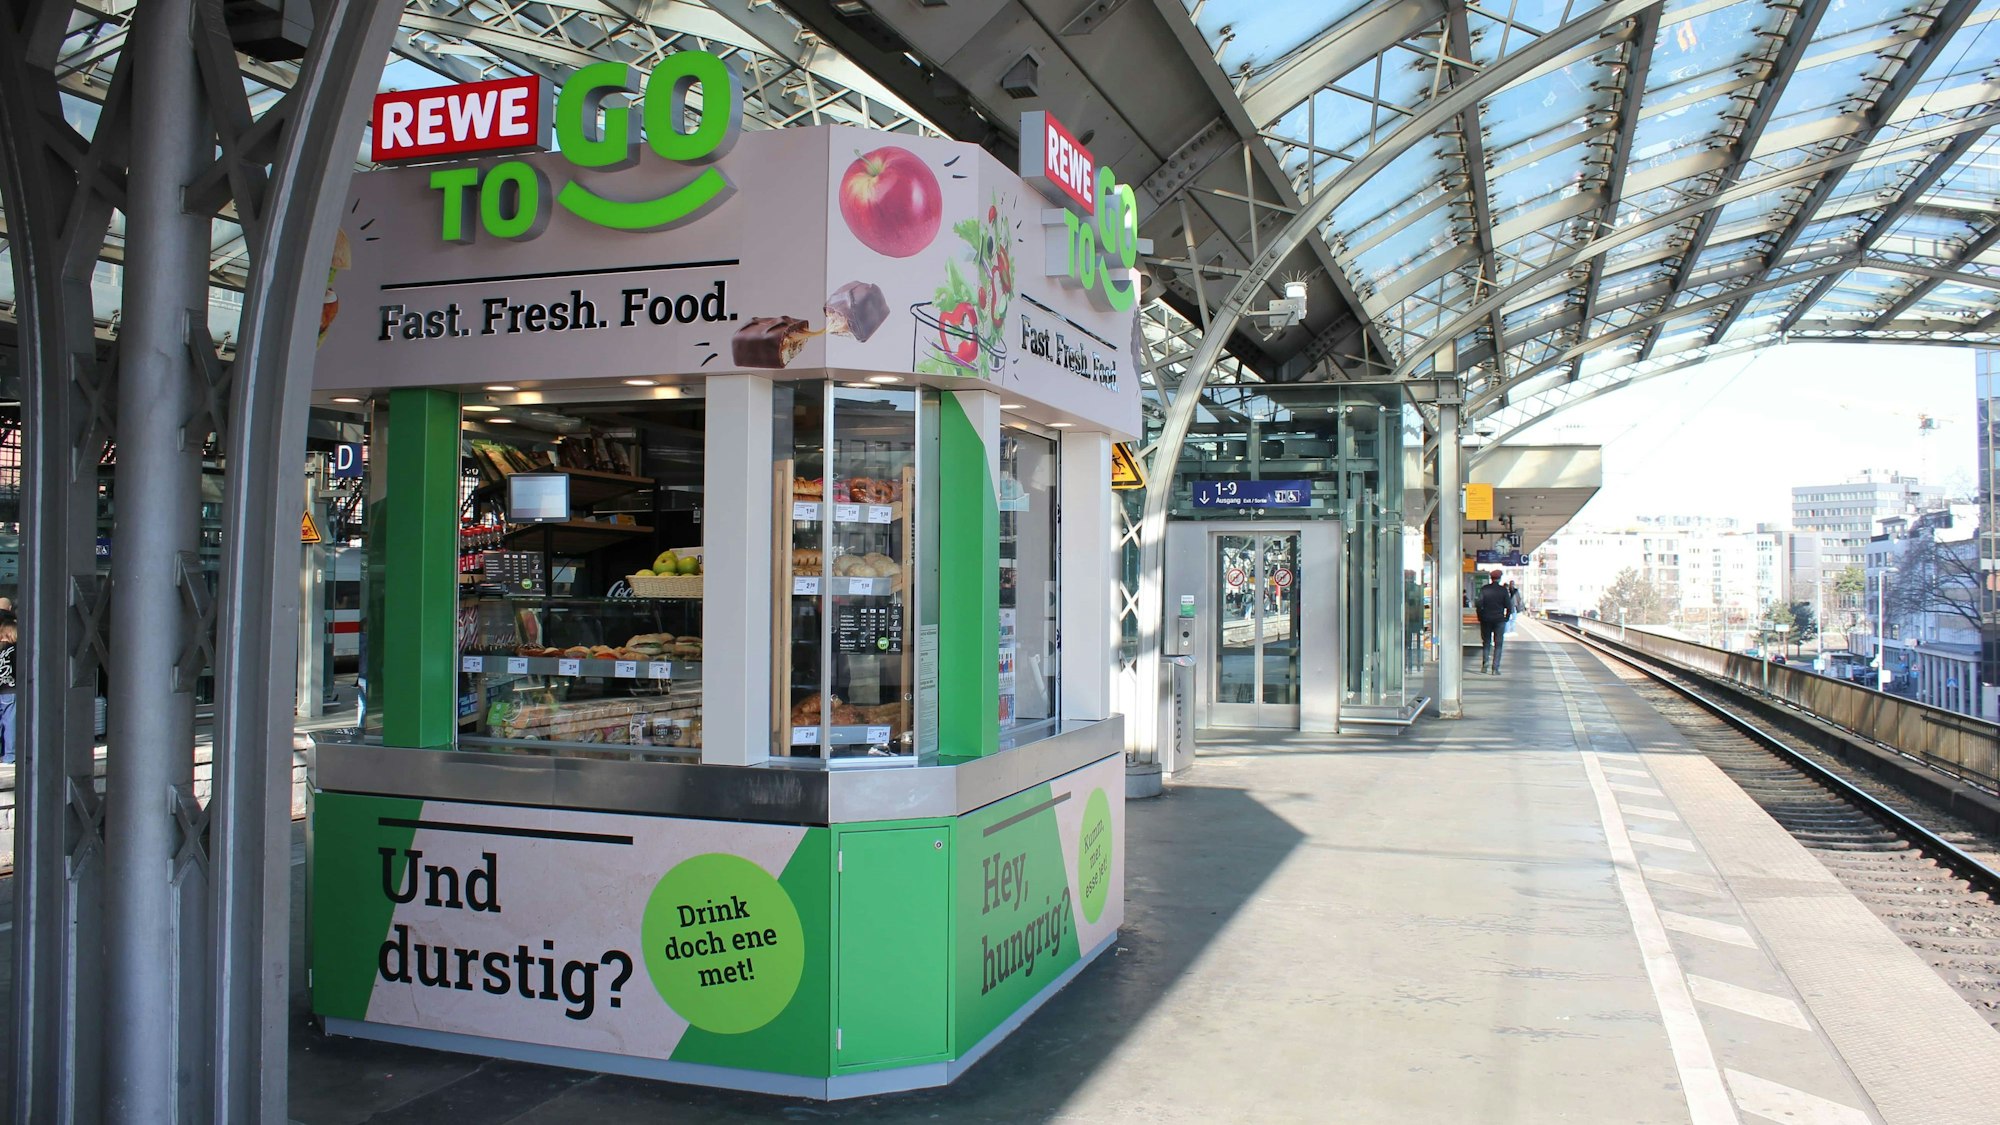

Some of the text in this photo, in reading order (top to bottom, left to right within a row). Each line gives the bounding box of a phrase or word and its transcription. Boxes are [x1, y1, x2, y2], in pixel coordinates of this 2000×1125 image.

[380, 86, 529, 150] REWE
[429, 50, 736, 242] TO GO
[1048, 124, 1092, 204] REWE
[1063, 165, 1138, 290] TO GO
[378, 280, 738, 342] Fast. Fresh. Food.
[1021, 314, 1120, 393] Fast. Fresh. Food.
[337, 444, 354, 470] D
[1215, 481, 1238, 496] 1-9
[1215, 497, 1241, 505] Ausgang
[1510, 535, 1519, 545] 11
[1520, 554, 1528, 564] C
[378, 847, 501, 913] Und
[1089, 843, 1101, 870] mer
[982, 851, 1029, 916] Hey,
[1085, 872, 1098, 898] esse
[677, 895, 750, 928] Drink
[665, 928, 778, 961] doch ene
[981, 886, 1071, 996] hungrig?
[378, 924, 634, 1021] durstig?
[698, 957, 755, 987] met!
